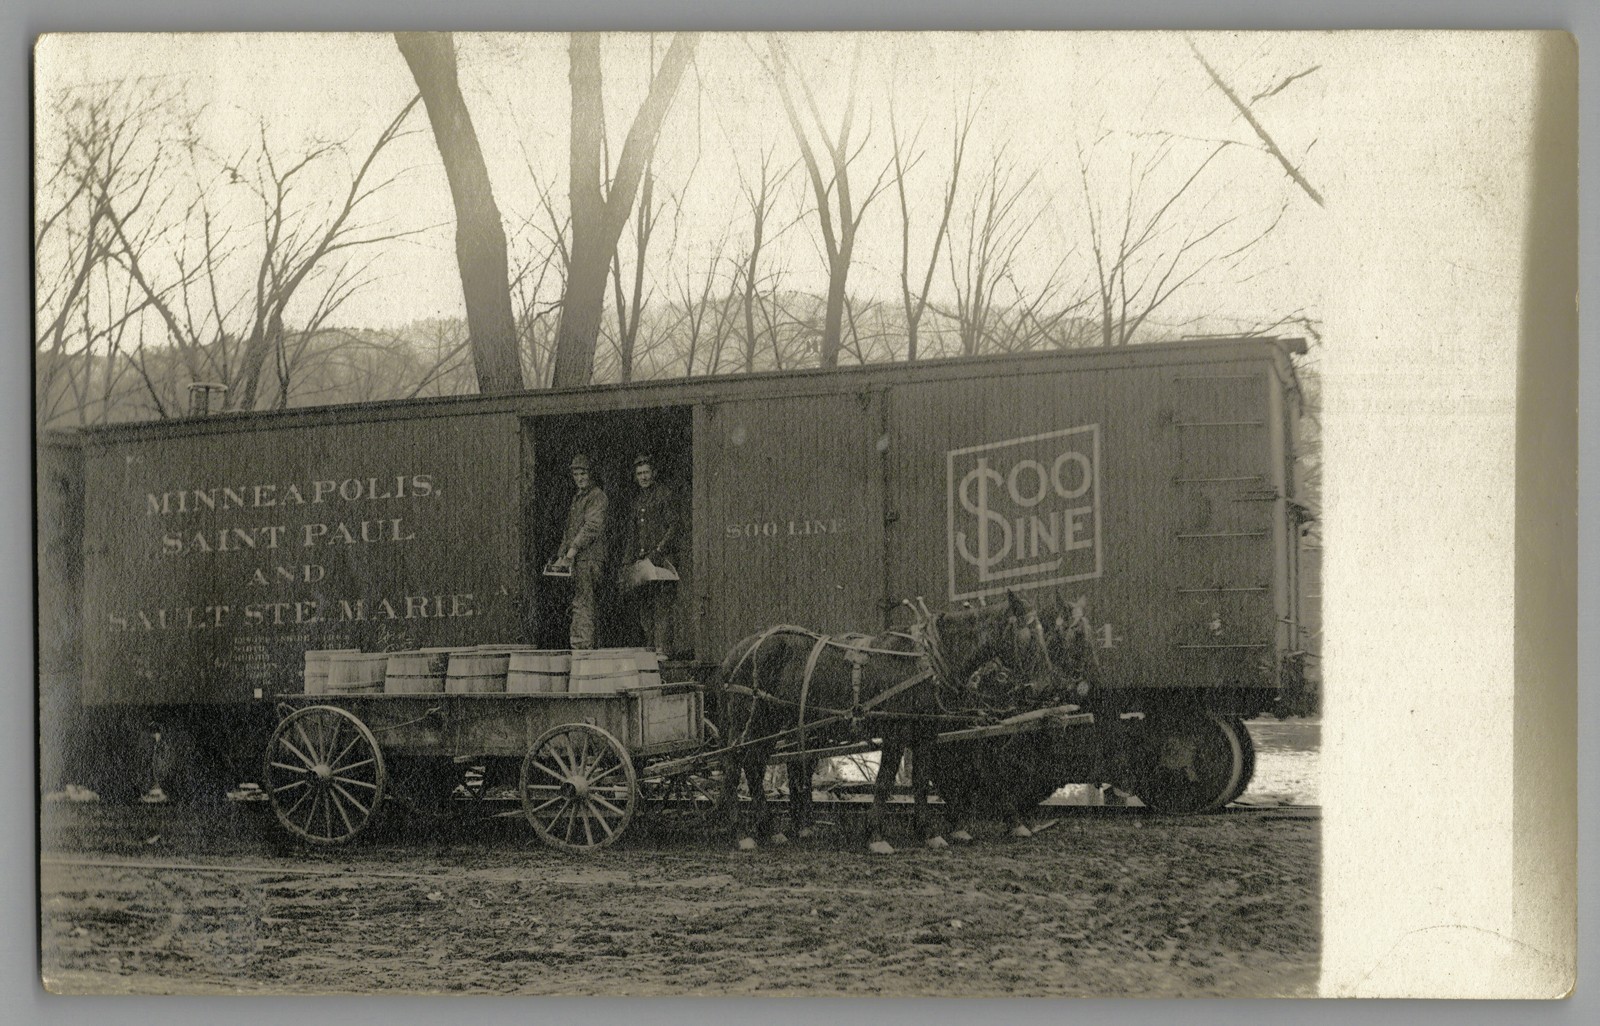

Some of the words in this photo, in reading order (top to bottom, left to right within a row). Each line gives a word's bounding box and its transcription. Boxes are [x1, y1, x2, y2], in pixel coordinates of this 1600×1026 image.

[146, 473, 443, 516] MINNEAPOLIS,
[162, 525, 286, 556] SAINT
[304, 517, 415, 548] PAUL
[726, 523, 778, 538] SOO
[249, 564, 326, 587] AND
[108, 604, 230, 633] SAULT
